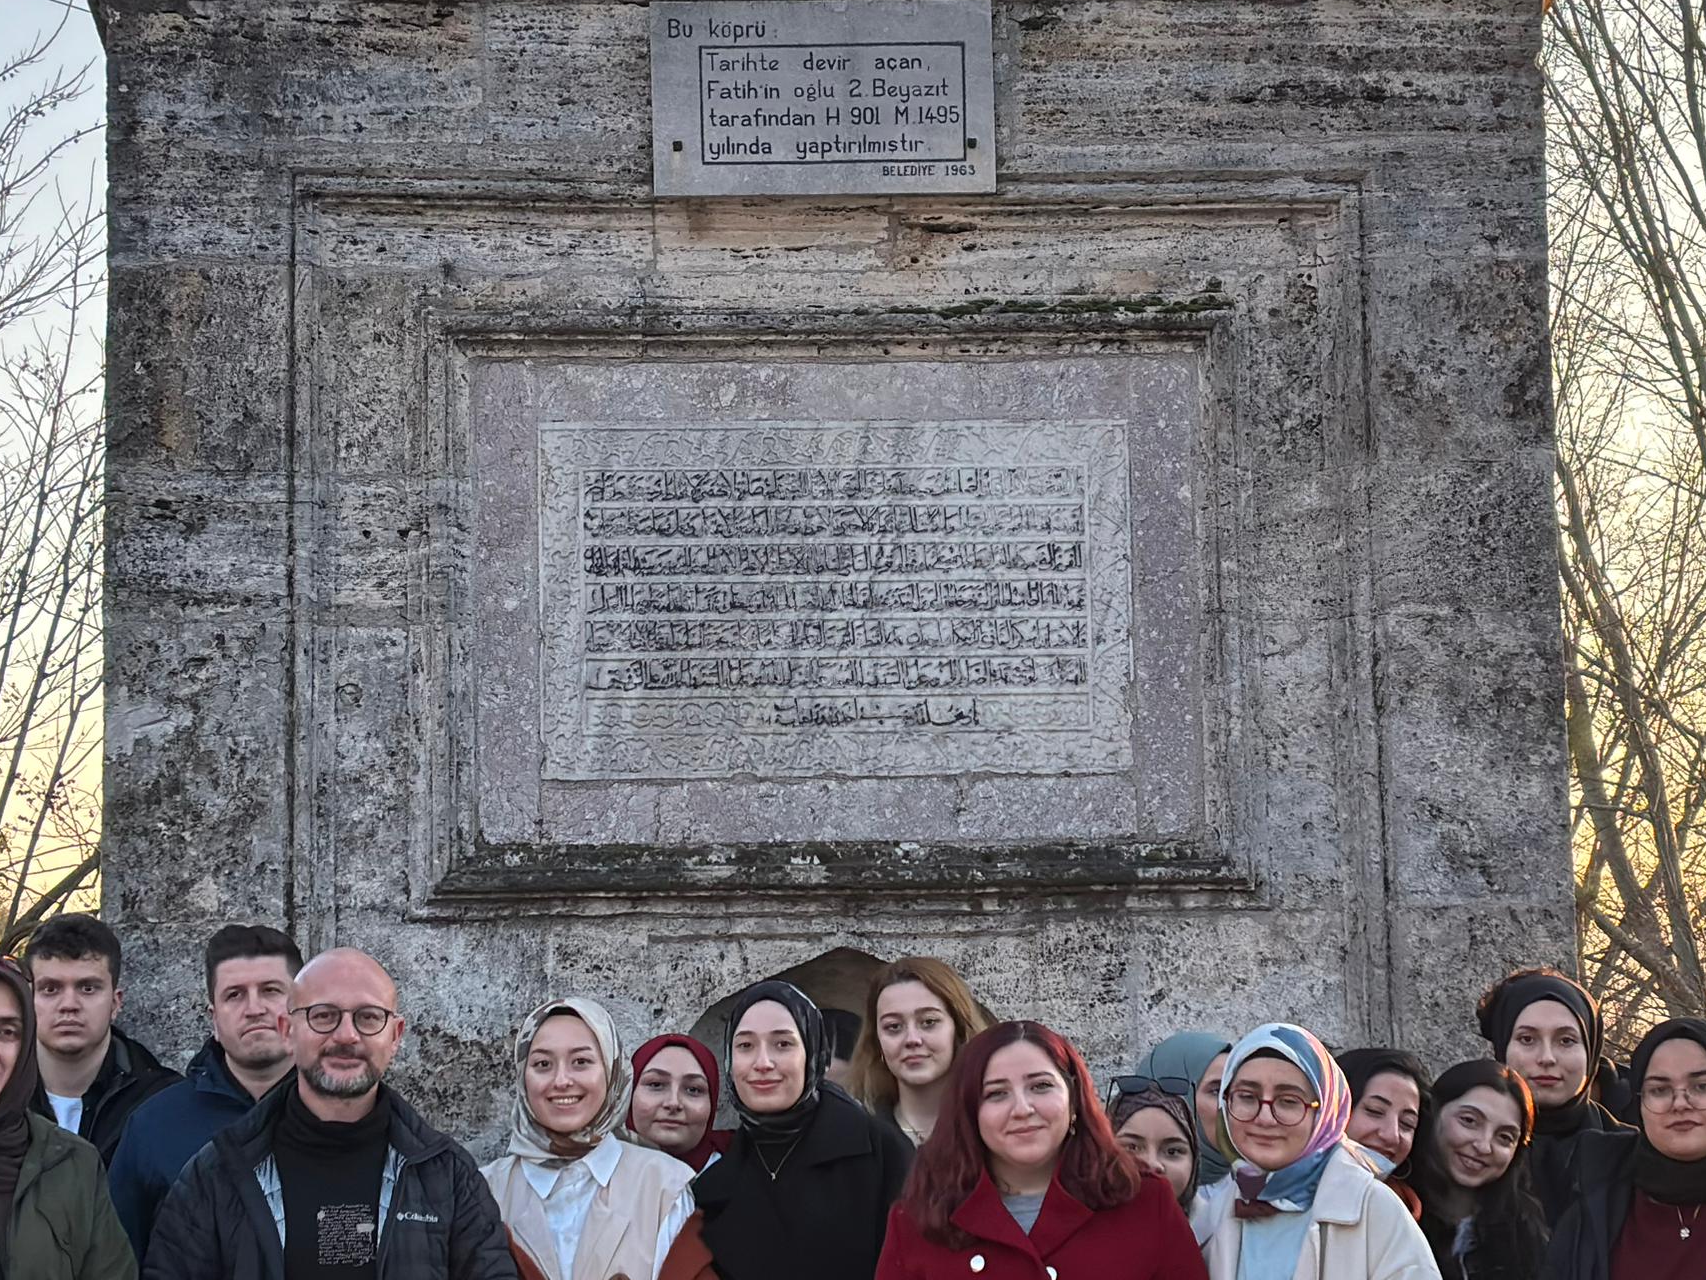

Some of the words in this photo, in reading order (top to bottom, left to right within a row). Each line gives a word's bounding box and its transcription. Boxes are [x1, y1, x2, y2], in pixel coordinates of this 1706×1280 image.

[667, 18, 693, 39] Bu
[706, 51, 780, 71] Tarihte
[803, 51, 851, 71] devir
[793, 78, 835, 102] oğlu
[708, 106, 816, 127] tarafından
[849, 106, 881, 126] 901
[708, 135, 773, 161] yılında
[882, 163, 936, 177] BELEDİYE
[945, 164, 976, 176] 1963
[404, 1211, 439, 1223] Colbia
